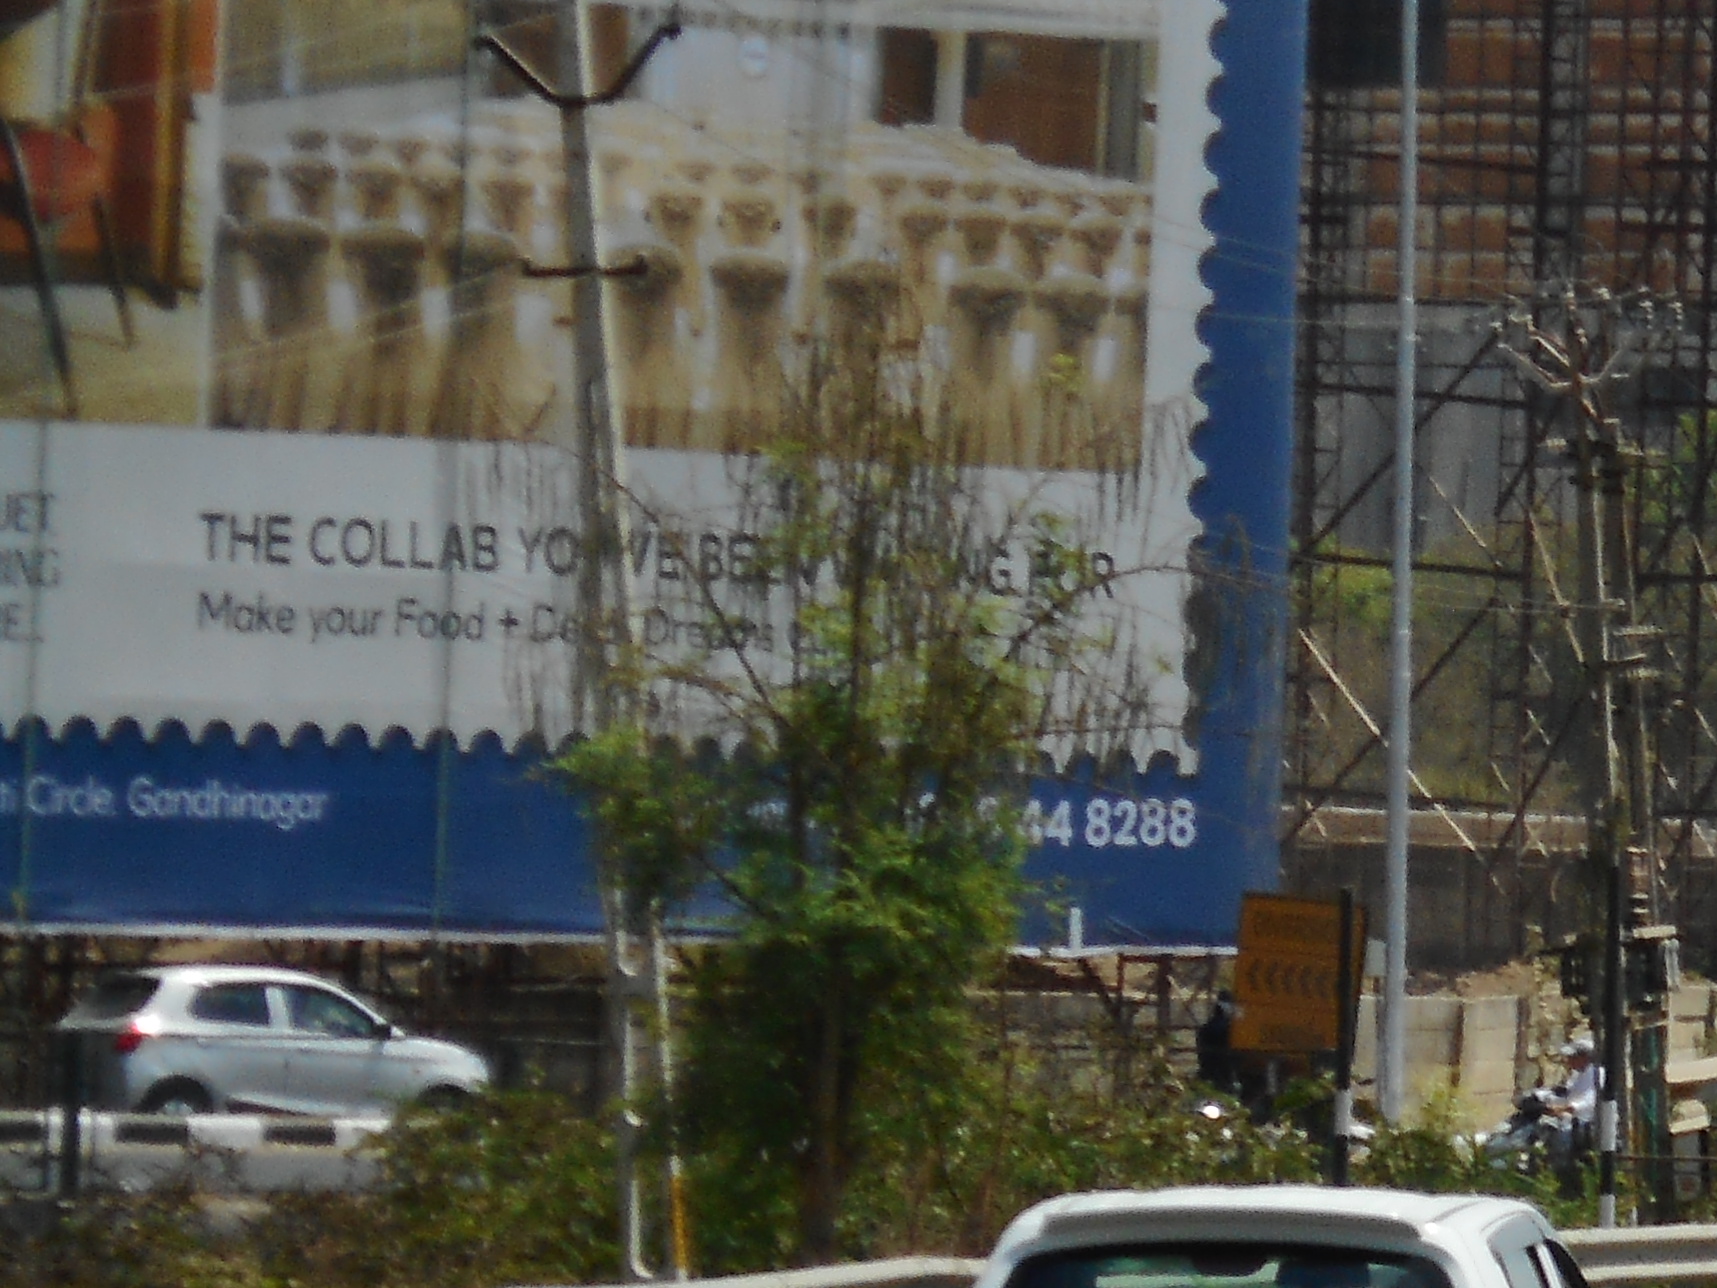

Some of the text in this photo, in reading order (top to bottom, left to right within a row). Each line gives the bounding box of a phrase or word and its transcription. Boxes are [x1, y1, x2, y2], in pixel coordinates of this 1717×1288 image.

[200, 512, 292, 565] THE
[309, 516, 498, 573] COLLAB
[198, 591, 295, 634] Make
[312, 606, 381, 643] your
[397, 599, 484, 640] Food
[1085, 798, 1196, 848] 8288
